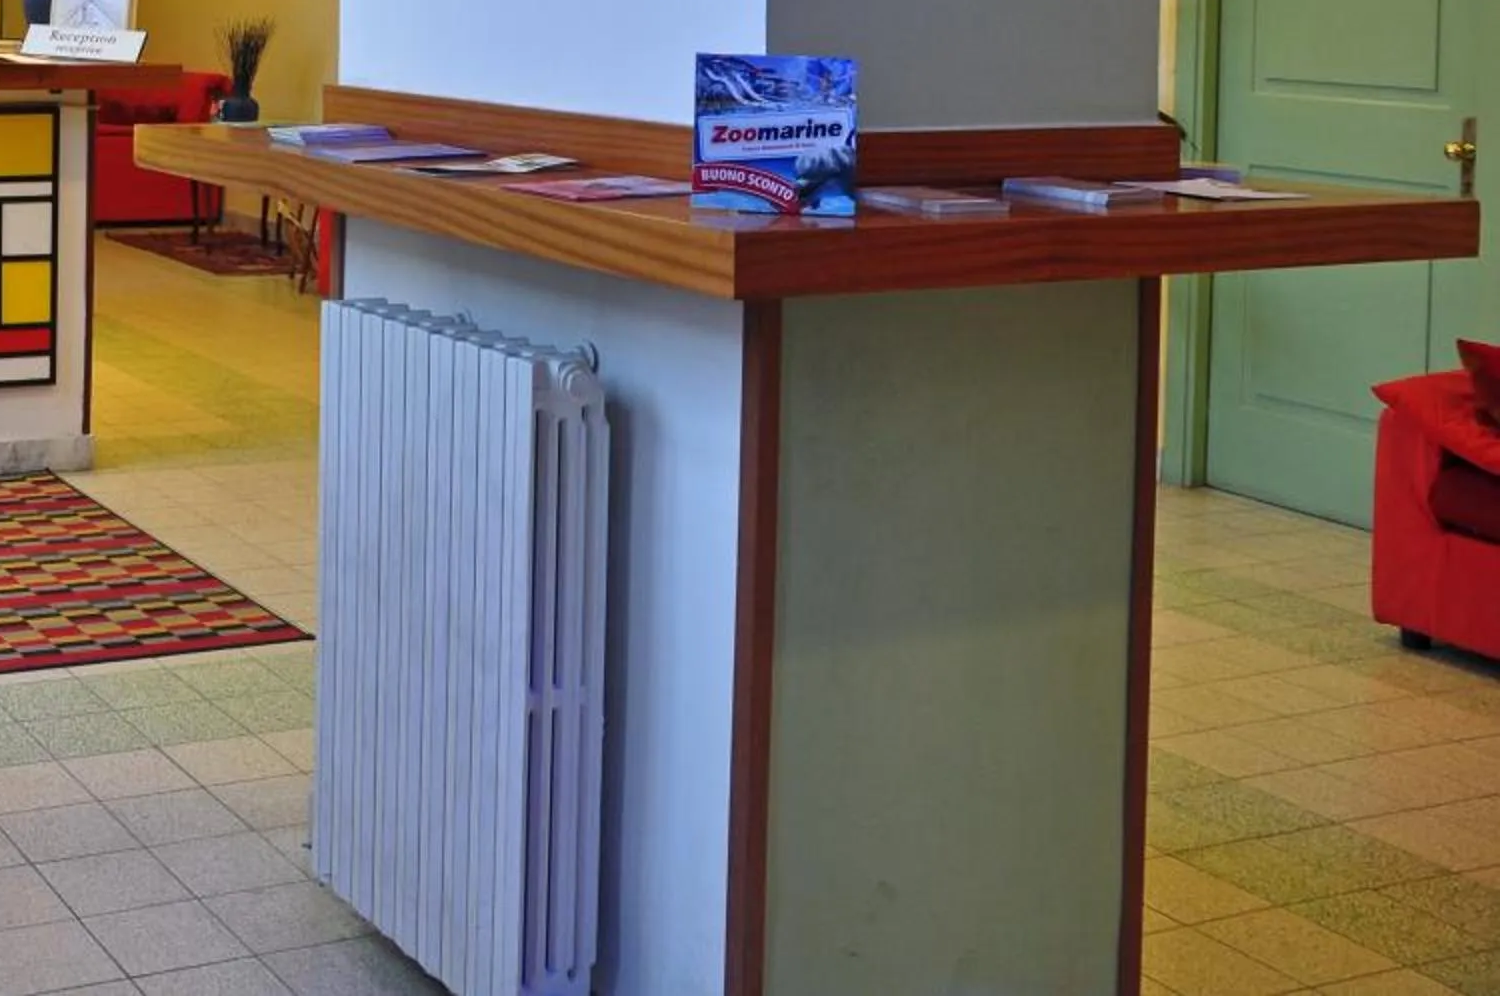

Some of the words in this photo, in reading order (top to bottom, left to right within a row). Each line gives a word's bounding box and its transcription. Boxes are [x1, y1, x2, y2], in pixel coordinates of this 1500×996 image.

[50, 30, 117, 45] Reception
[711, 118, 842, 144] Zoomarine
[701, 169, 745, 184] BUONO
[747, 173, 793, 201] SCONTO
